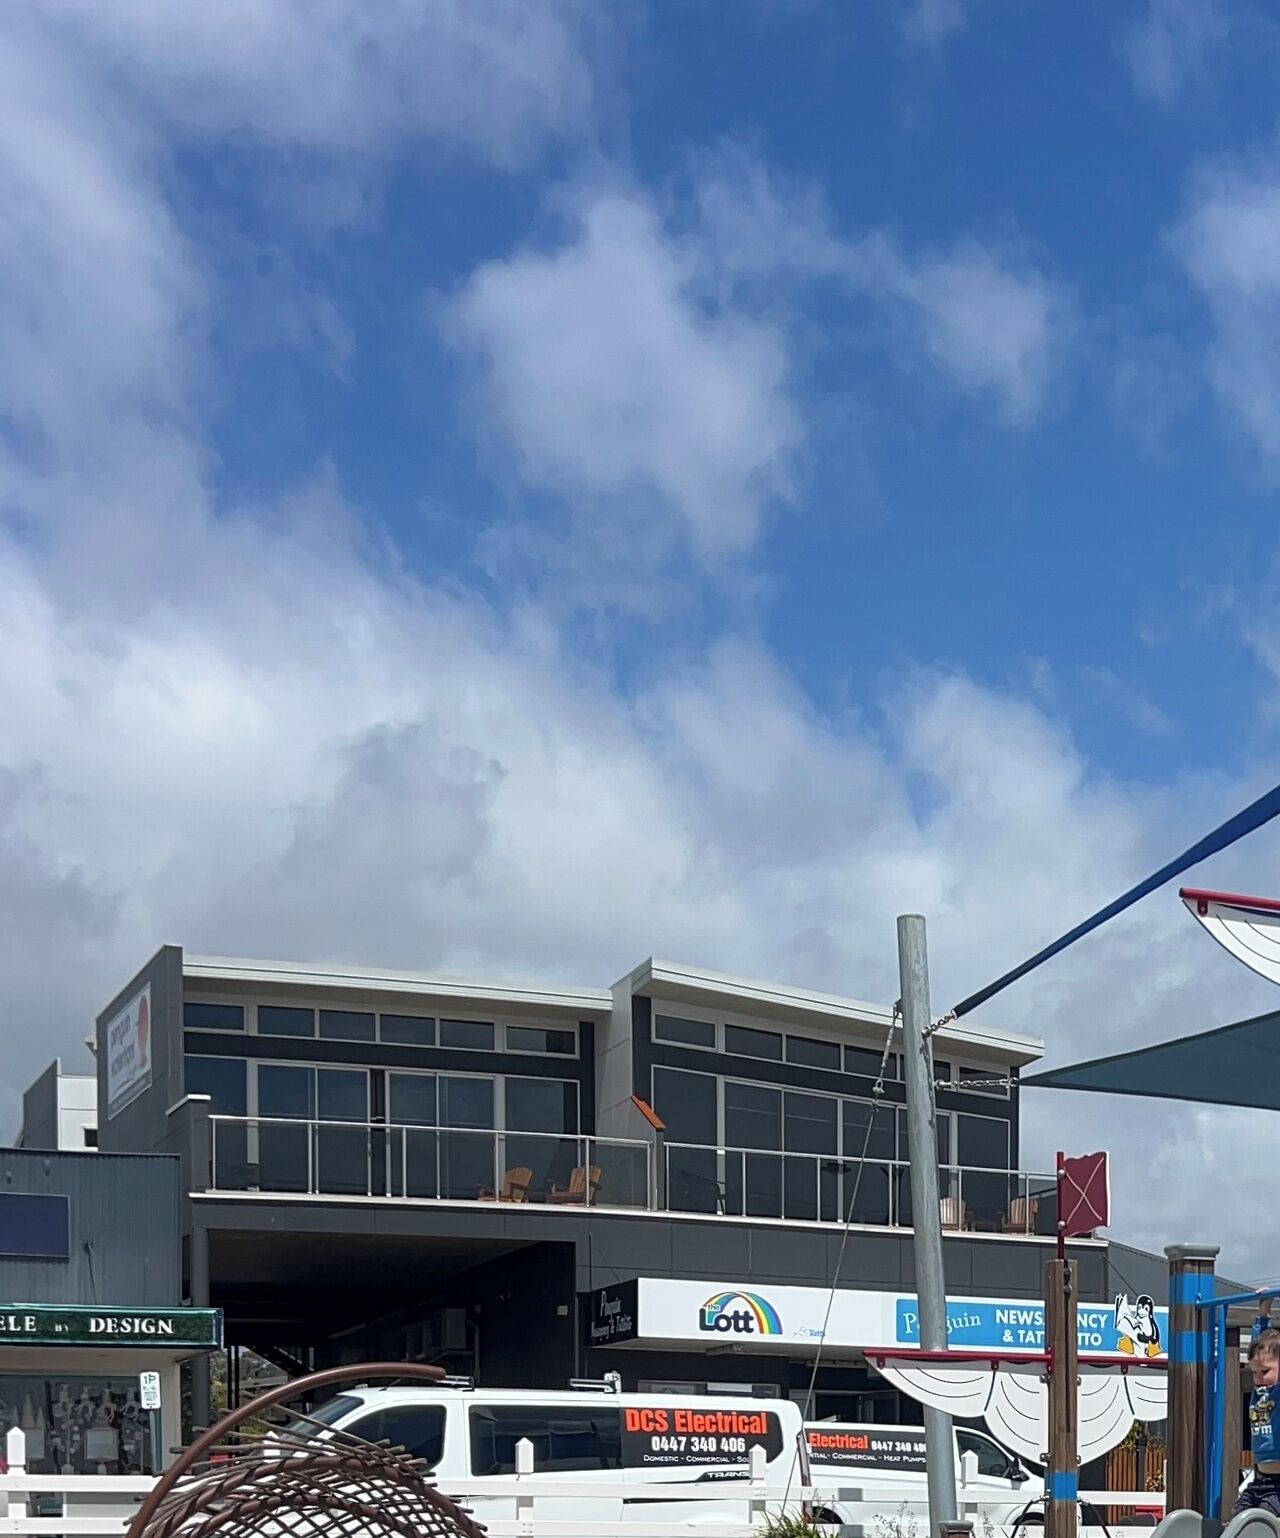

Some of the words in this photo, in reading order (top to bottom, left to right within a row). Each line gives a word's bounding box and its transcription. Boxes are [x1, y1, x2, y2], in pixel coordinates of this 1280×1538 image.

[89, 1317, 174, 1334] DESIGN
[903, 1312, 982, 1334] Pguin
[995, 1309, 1108, 1329] NEWSNCY
[1002, 1329, 1014, 1343] &
[625, 1408, 669, 1433] DCS
[674, 1410, 768, 1434] Electrical
[651, 1435, 687, 1452] 0447
[691, 1436, 717, 1452] 340
[720, 1437, 746, 1453] 406
[808, 1432, 869, 1450] Electrical
[871, 1440, 894, 1452] 0447
[895, 1441, 911, 1453] 340
